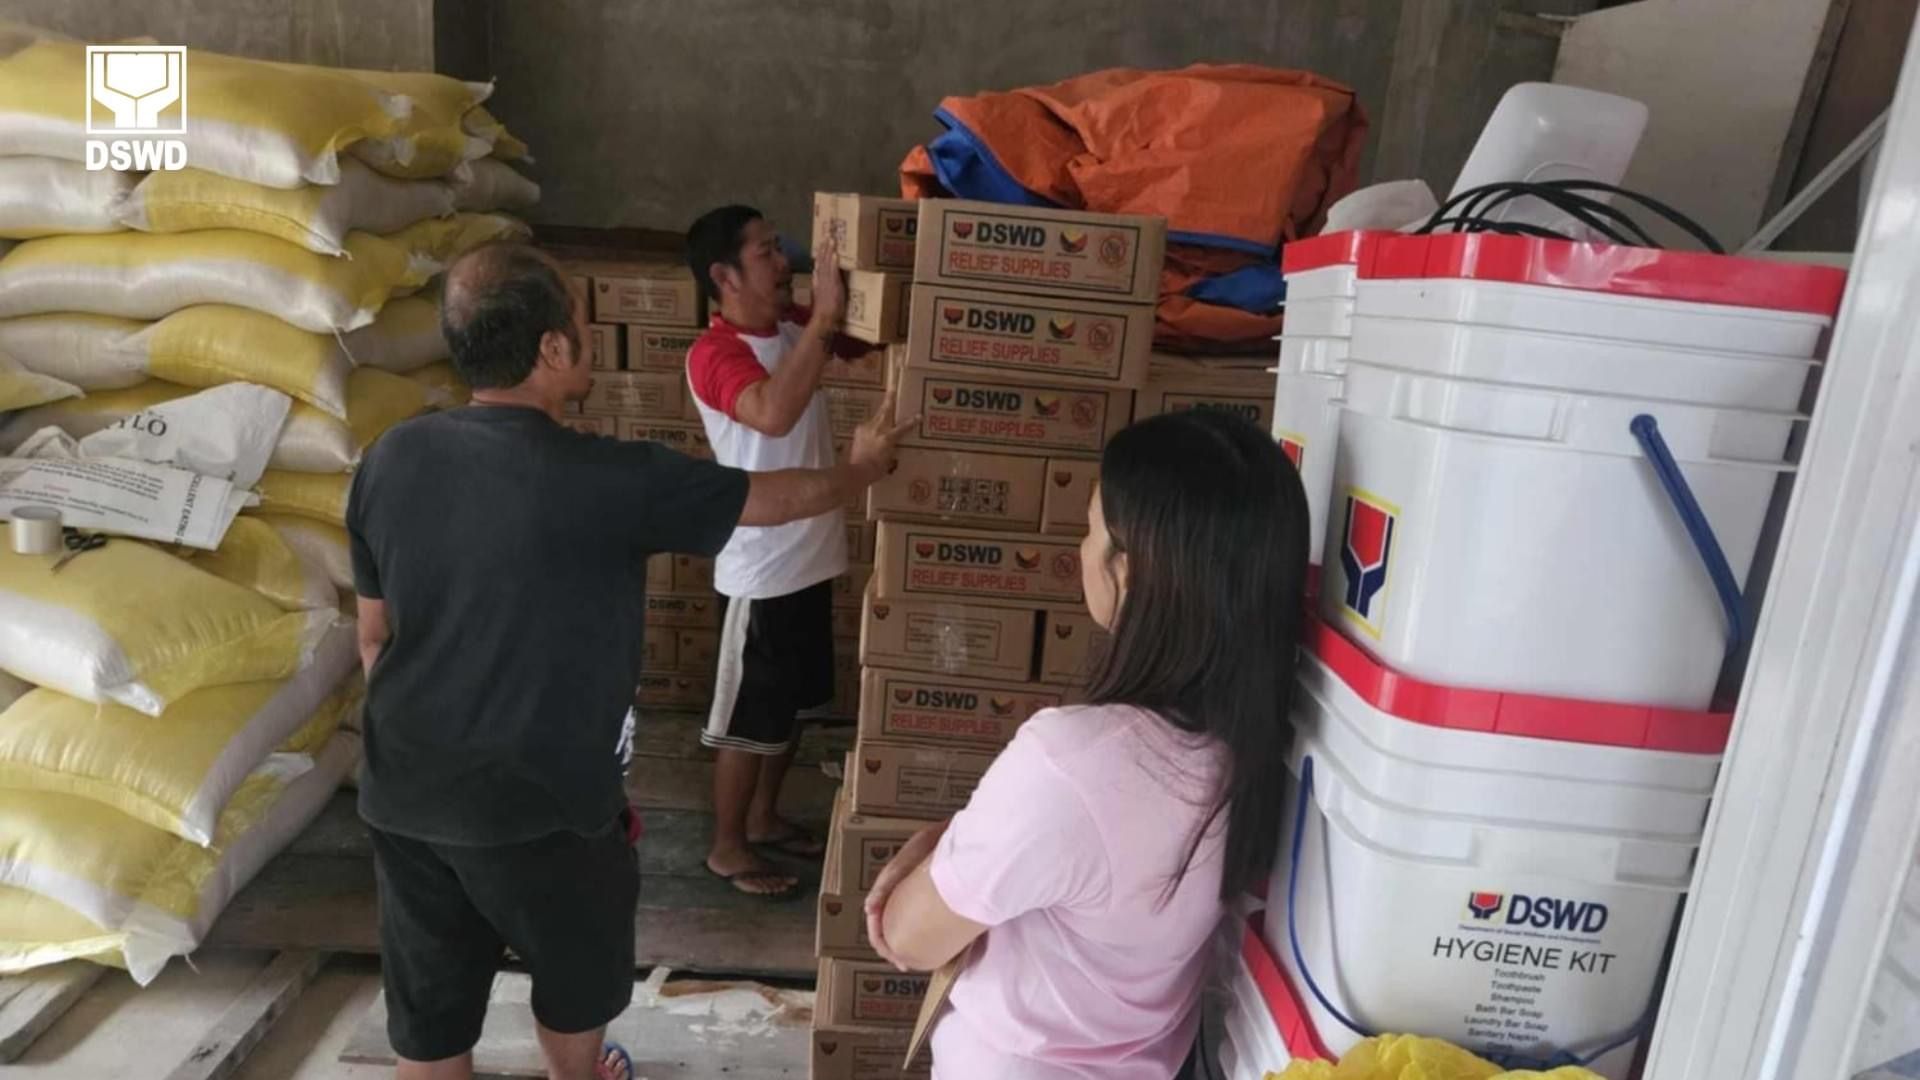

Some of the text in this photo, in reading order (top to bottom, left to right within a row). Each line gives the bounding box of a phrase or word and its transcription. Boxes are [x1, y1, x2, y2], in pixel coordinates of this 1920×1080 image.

[977, 222, 1046, 247] DSWD
[949, 252, 1072, 279] RELIEF SUPPLIES
[967, 309, 1035, 333] DSWD
[940, 338, 1061, 364] RELIEF SUPPLIES
[956, 389, 1021, 411] DSWD
[928, 416, 1045, 439] RELIEF SUPPLIES
[938, 544, 1002, 565] DSWD
[911, 569, 1027, 591] RELIEF SUPPLIES
[916, 689, 978, 710] DSWD
[890, 714, 1003, 736] RELIEF SUPPLIES
[1506, 894, 1608, 933] DSWD
[1433, 937, 1616, 974] HYGIENE KIT
[1495, 968, 1545, 981] Toothbrush
[883, 980, 928, 996] DSW
[1491, 981, 1541, 993] Toothpaste
[1475, 1004, 1543, 1019] Bath Bar Soap
[1464, 1016, 1549, 1032] Laundry Bar Soap
[1467, 1028, 1539, 1042] Sanitary Napkin
